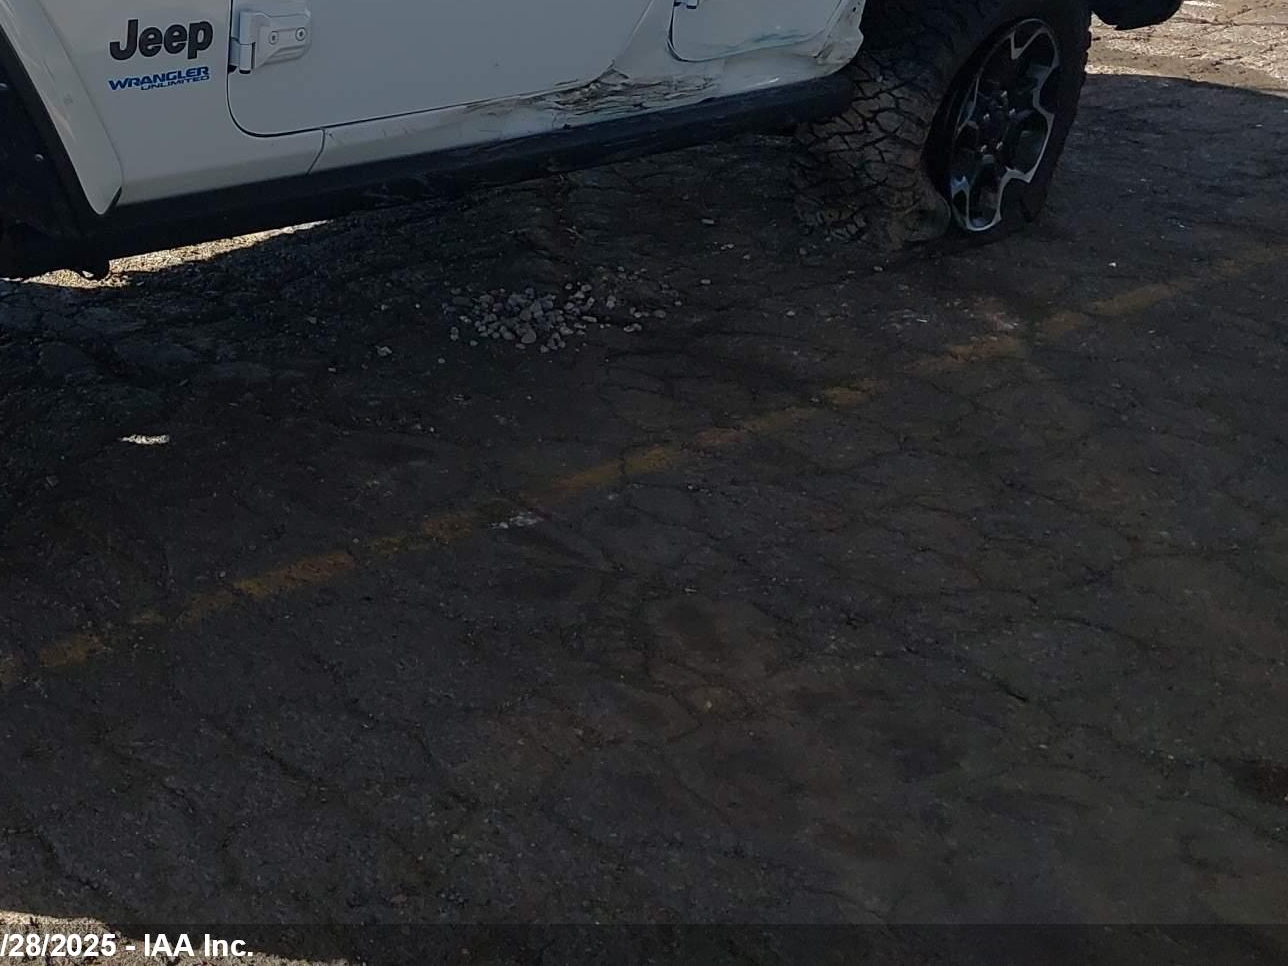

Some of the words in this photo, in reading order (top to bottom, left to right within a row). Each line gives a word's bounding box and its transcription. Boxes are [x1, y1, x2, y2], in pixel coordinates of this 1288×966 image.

[109, 19, 214, 61] Jeep
[108, 66, 210, 91] WRANGLER
[140, 75, 210, 91] UNLIMITED
